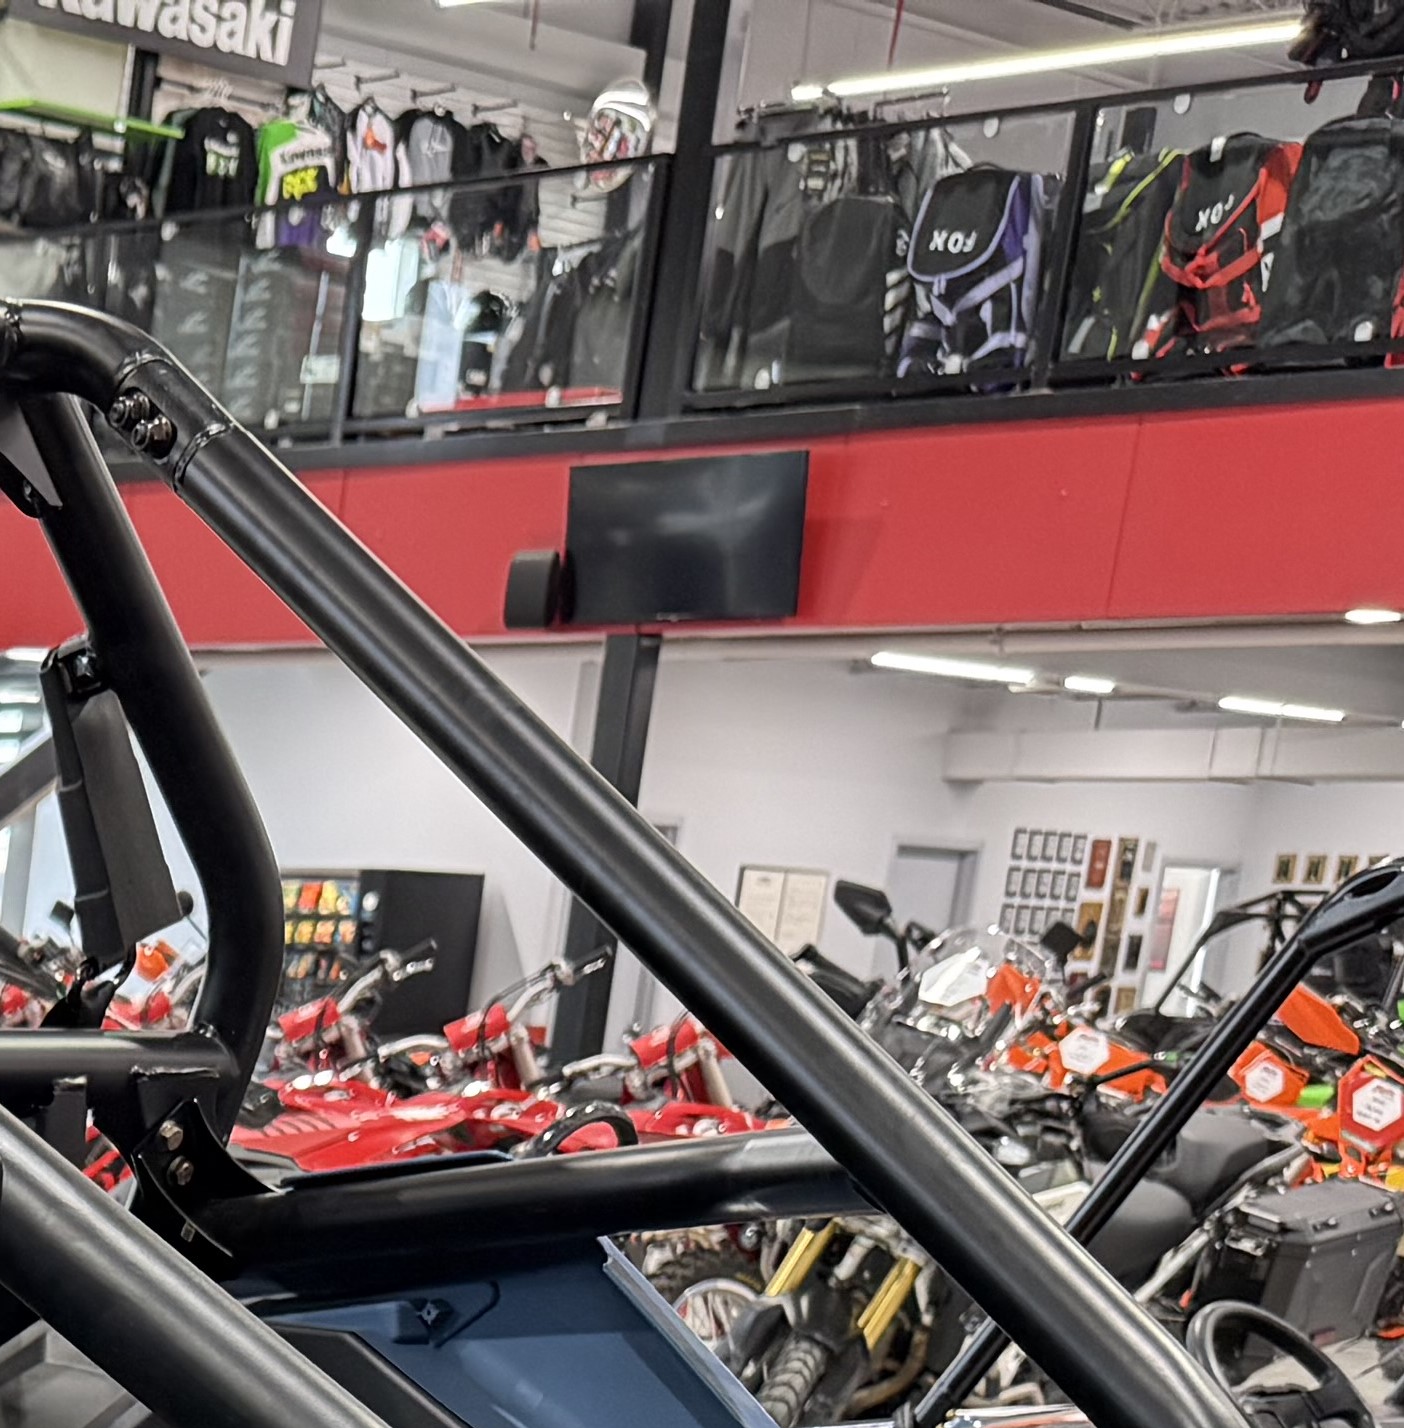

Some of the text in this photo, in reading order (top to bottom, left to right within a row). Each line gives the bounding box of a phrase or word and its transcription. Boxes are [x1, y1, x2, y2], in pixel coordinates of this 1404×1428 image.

[37, 0, 295, 66] wasaki
[1195, 193, 1235, 233] FOX
[928, 229, 978, 254] FOX
